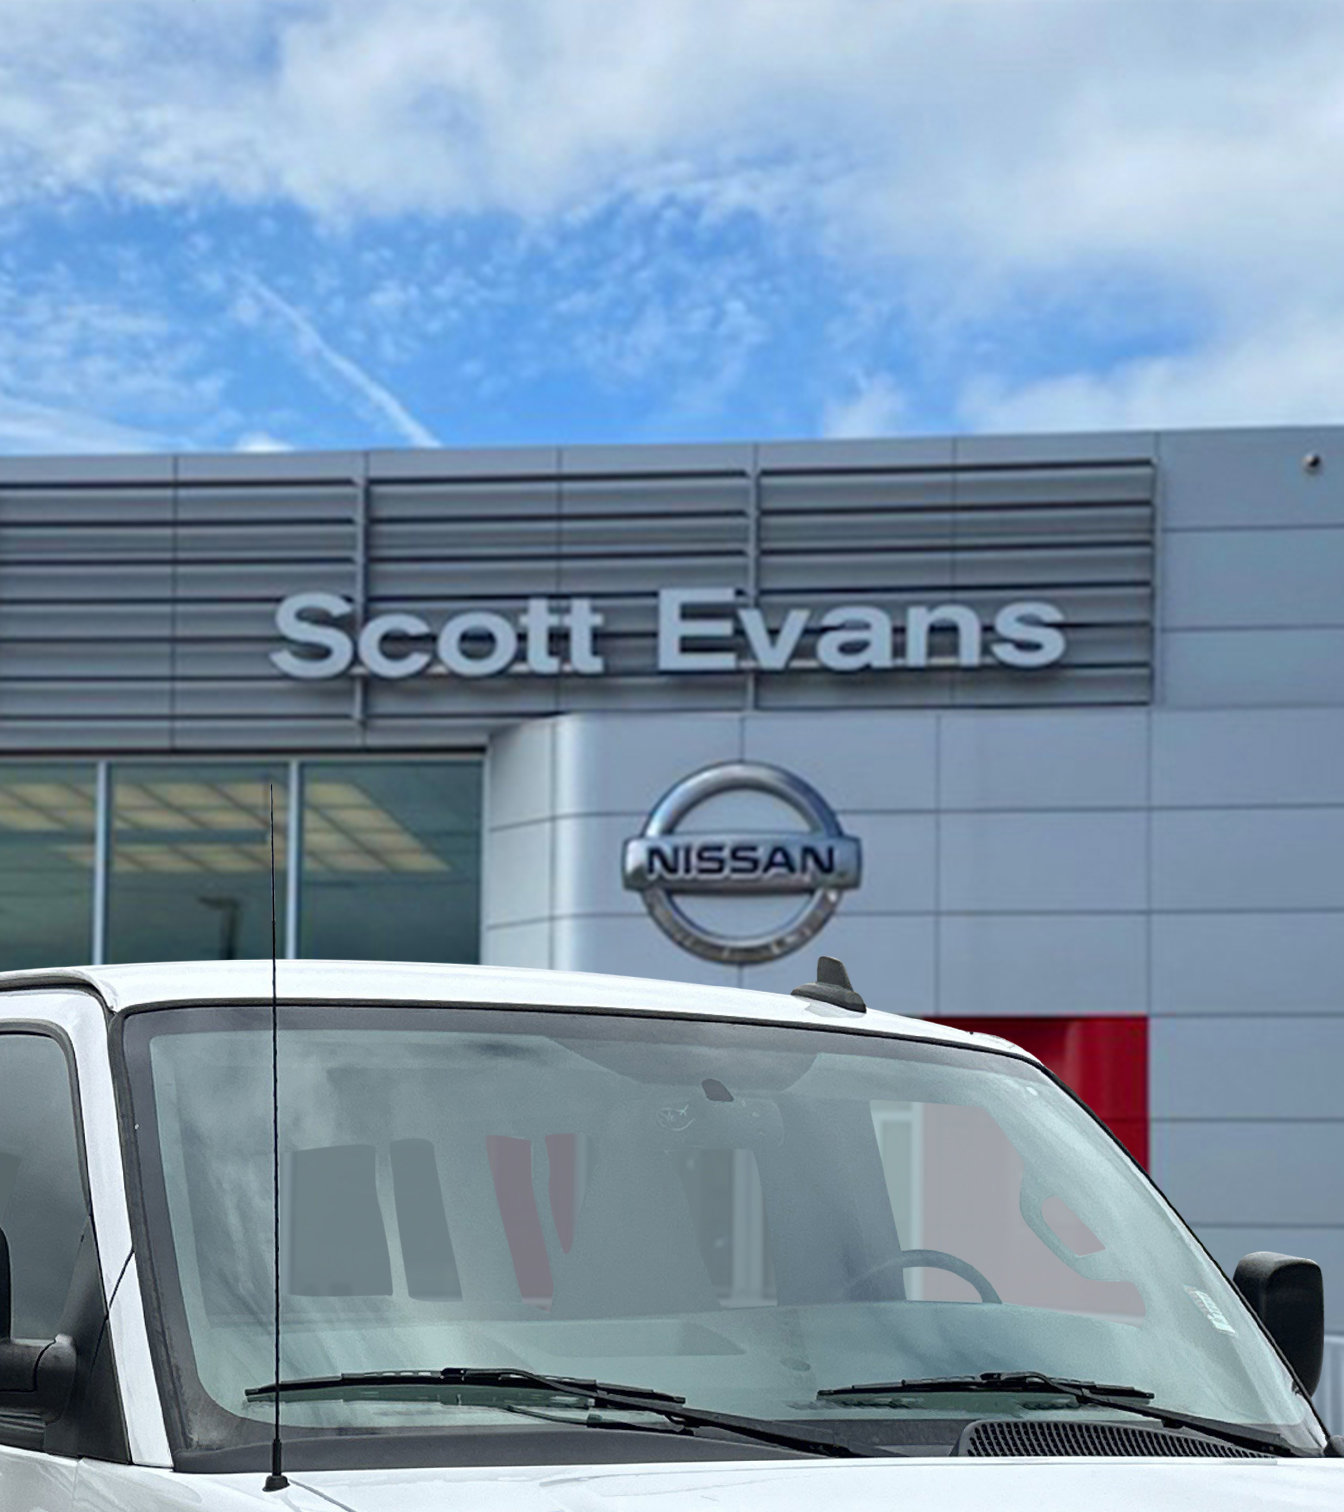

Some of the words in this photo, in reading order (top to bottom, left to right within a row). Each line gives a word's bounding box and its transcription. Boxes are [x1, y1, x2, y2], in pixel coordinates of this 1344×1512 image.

[269, 590, 606, 680] Scott
[658, 587, 1067, 673] Evans
[646, 845, 837, 881] NISSAN
